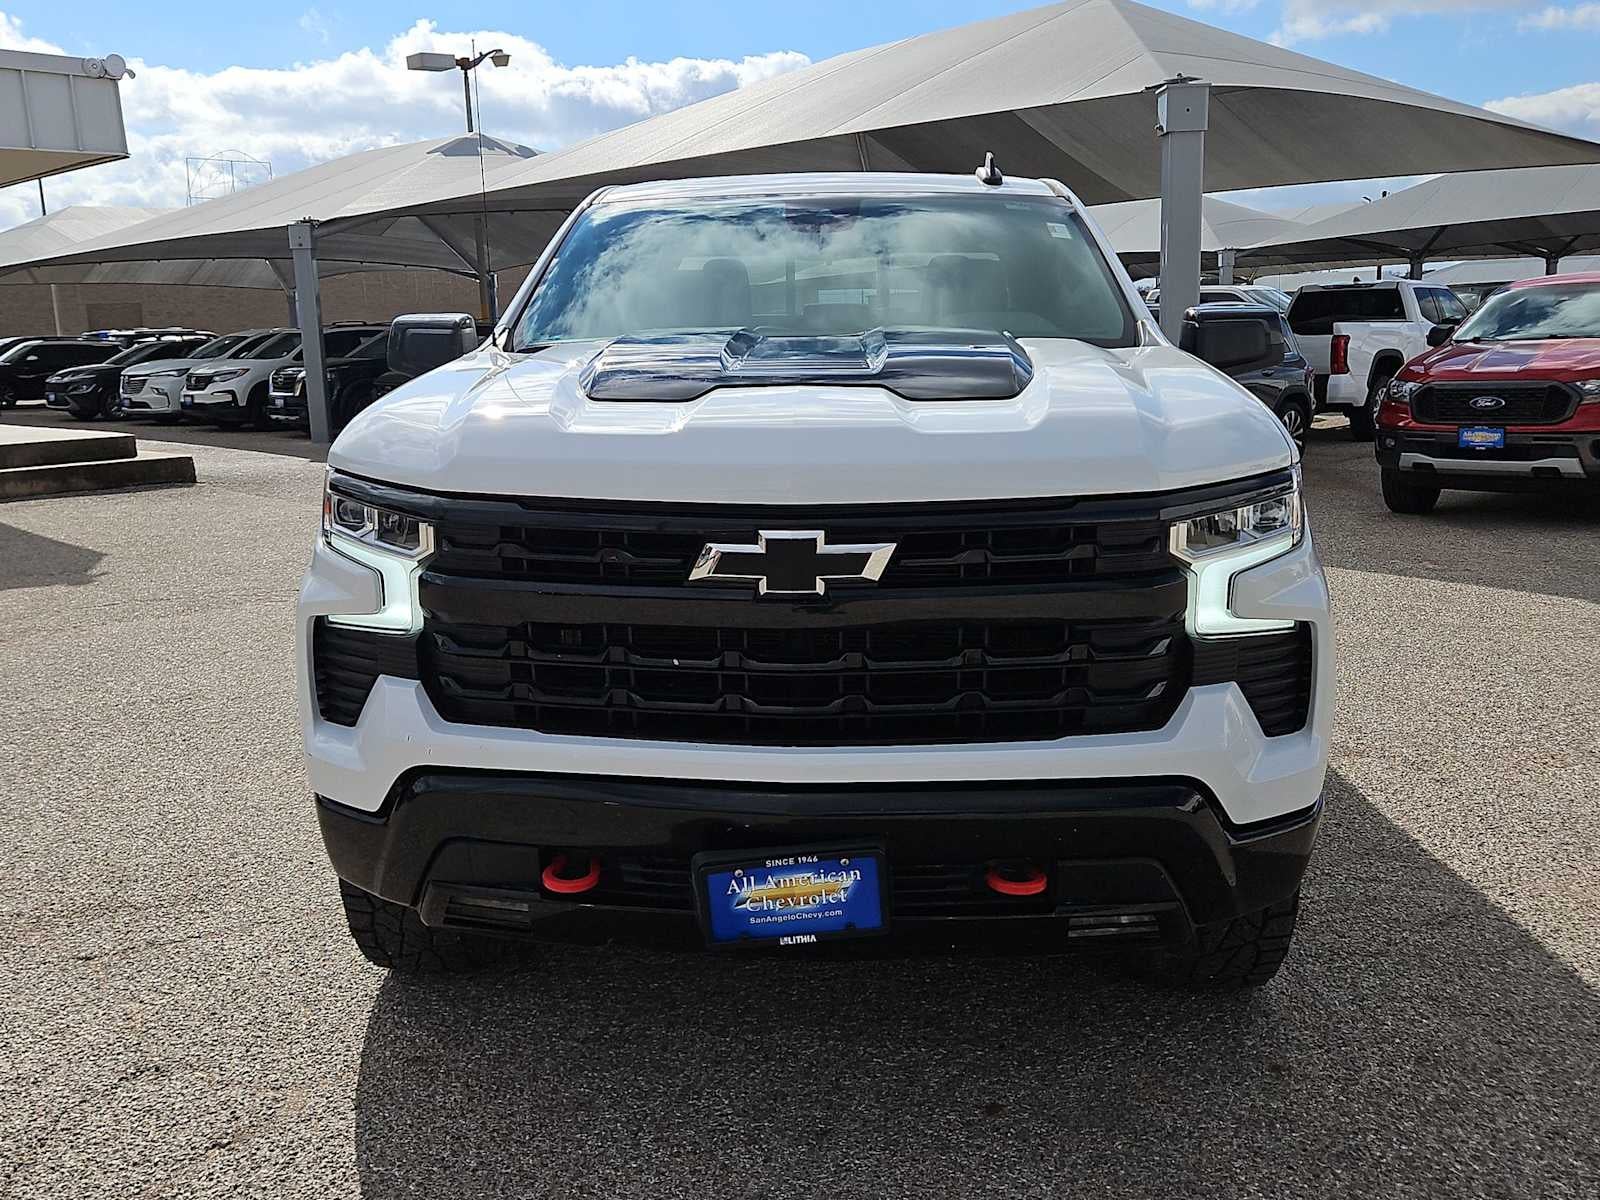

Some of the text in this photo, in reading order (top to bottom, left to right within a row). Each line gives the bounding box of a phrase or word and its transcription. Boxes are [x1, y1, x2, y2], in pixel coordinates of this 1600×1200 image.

[1476, 399, 1496, 407] Ford
[765, 856, 818, 868] SINCE 1946
[727, 869, 861, 895] All American
[746, 889, 848, 912] Chevrolet
[750, 910, 843, 924] SanAngeloChevy.com
